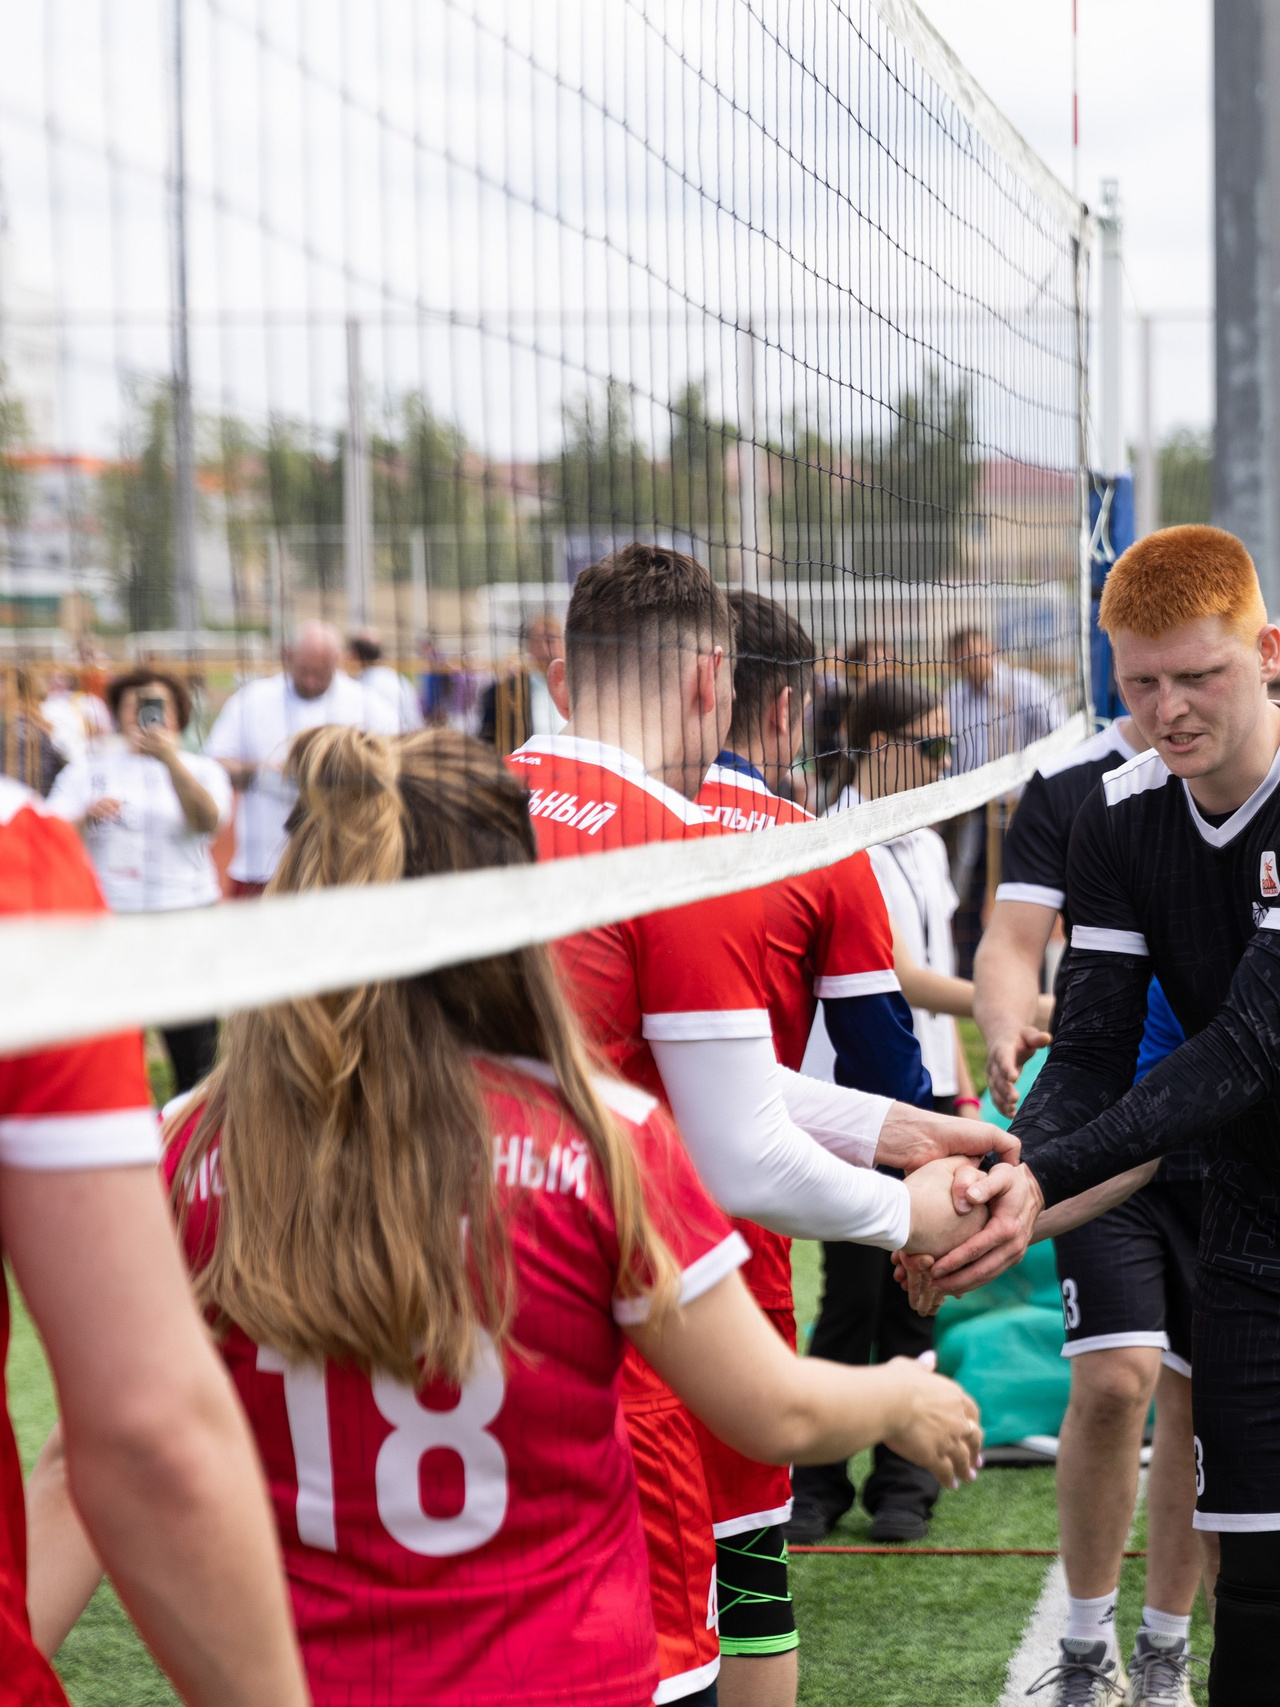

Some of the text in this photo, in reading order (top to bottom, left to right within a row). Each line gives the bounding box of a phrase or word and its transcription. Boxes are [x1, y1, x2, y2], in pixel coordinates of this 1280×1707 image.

[527, 788, 618, 836] ЬНЫЙ
[493, 1134, 588, 1200] НЫЙ
[1061, 1278, 1081, 1330] 3
[256, 1326, 508, 1558] 18
